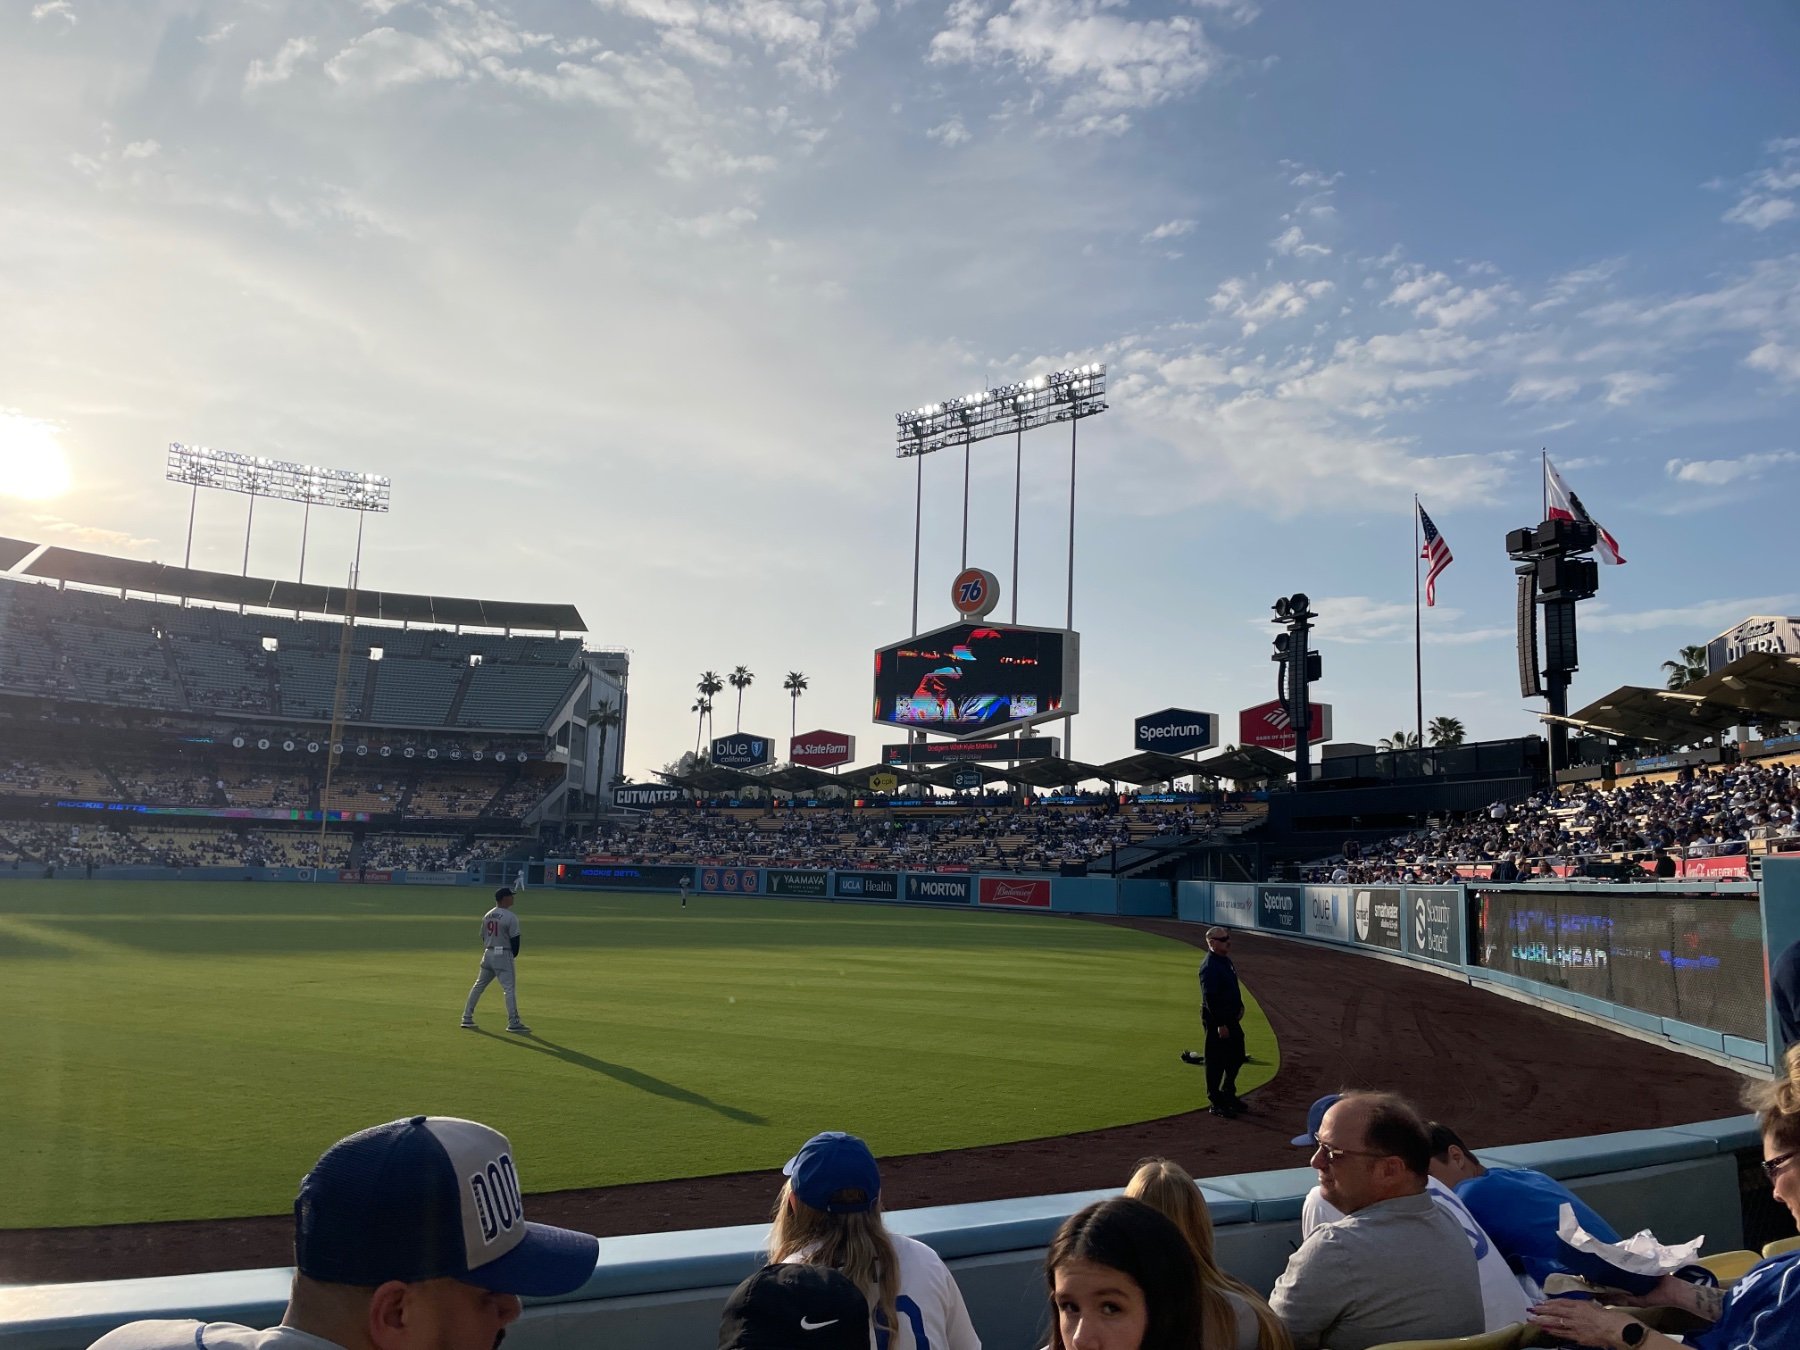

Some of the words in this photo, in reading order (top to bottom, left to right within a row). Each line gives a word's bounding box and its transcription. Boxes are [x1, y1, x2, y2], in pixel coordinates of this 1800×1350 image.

[960, 578, 982, 602] 76
[1726, 637, 1785, 663] ULTRA
[1140, 724, 1200, 742] Spectrum
[716, 740, 748, 755] blue
[617, 790, 678, 803] CUTWATER
[706, 875, 716, 885] 76
[726, 875, 736, 886] 76
[744, 876, 754, 886] 76
[842, 880, 860, 890] UCLA
[865, 880, 892, 892] Health
[921, 882, 964, 896] MORTON
[997, 886, 1032, 897] Budweiser
[1264, 892, 1292, 912] Spectrum
[1426, 900, 1450, 930] Security
[487, 920, 498, 936] 91
